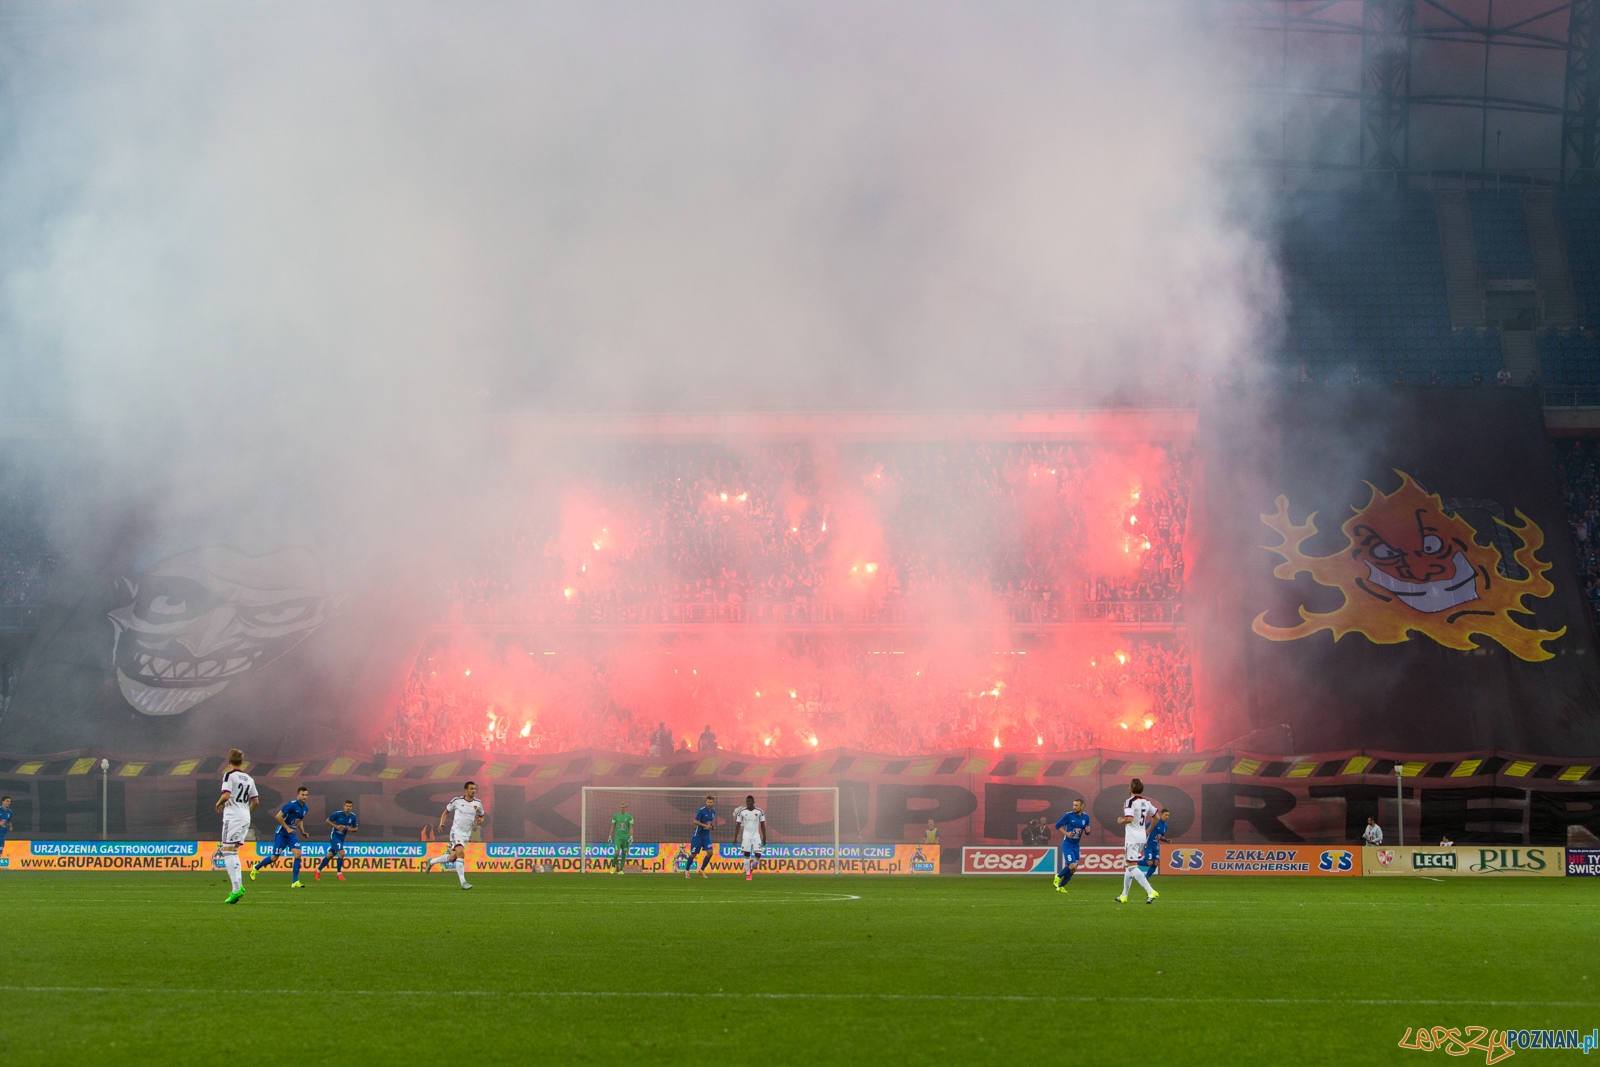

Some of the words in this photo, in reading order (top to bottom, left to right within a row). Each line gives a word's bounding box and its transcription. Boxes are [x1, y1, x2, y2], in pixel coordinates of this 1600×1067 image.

[235, 782, 251, 804] 26
[1139, 808, 1147, 827] 5
[33, 844, 98, 856] URZĄDZENIA
[99, 844, 193, 855] GASTRONOMICZNE
[489, 846, 556, 858] URZĄDZENIA
[1225, 850, 1298, 861] ZAKŁADY
[20, 856, 203, 872] www.GRUPADORAMETAL.pl
[969, 851, 1029, 869] tesa
[1067, 854, 1073, 862] 8
[1169, 848, 1204, 870] STS
[1318, 850, 1353, 872] STS
[1415, 855, 1454, 866] LECH
[1474, 849, 1546, 872] PILS
[1568, 854, 1586, 864] NIE
[1210, 862, 1310, 871] BUKMACHERSKIE
